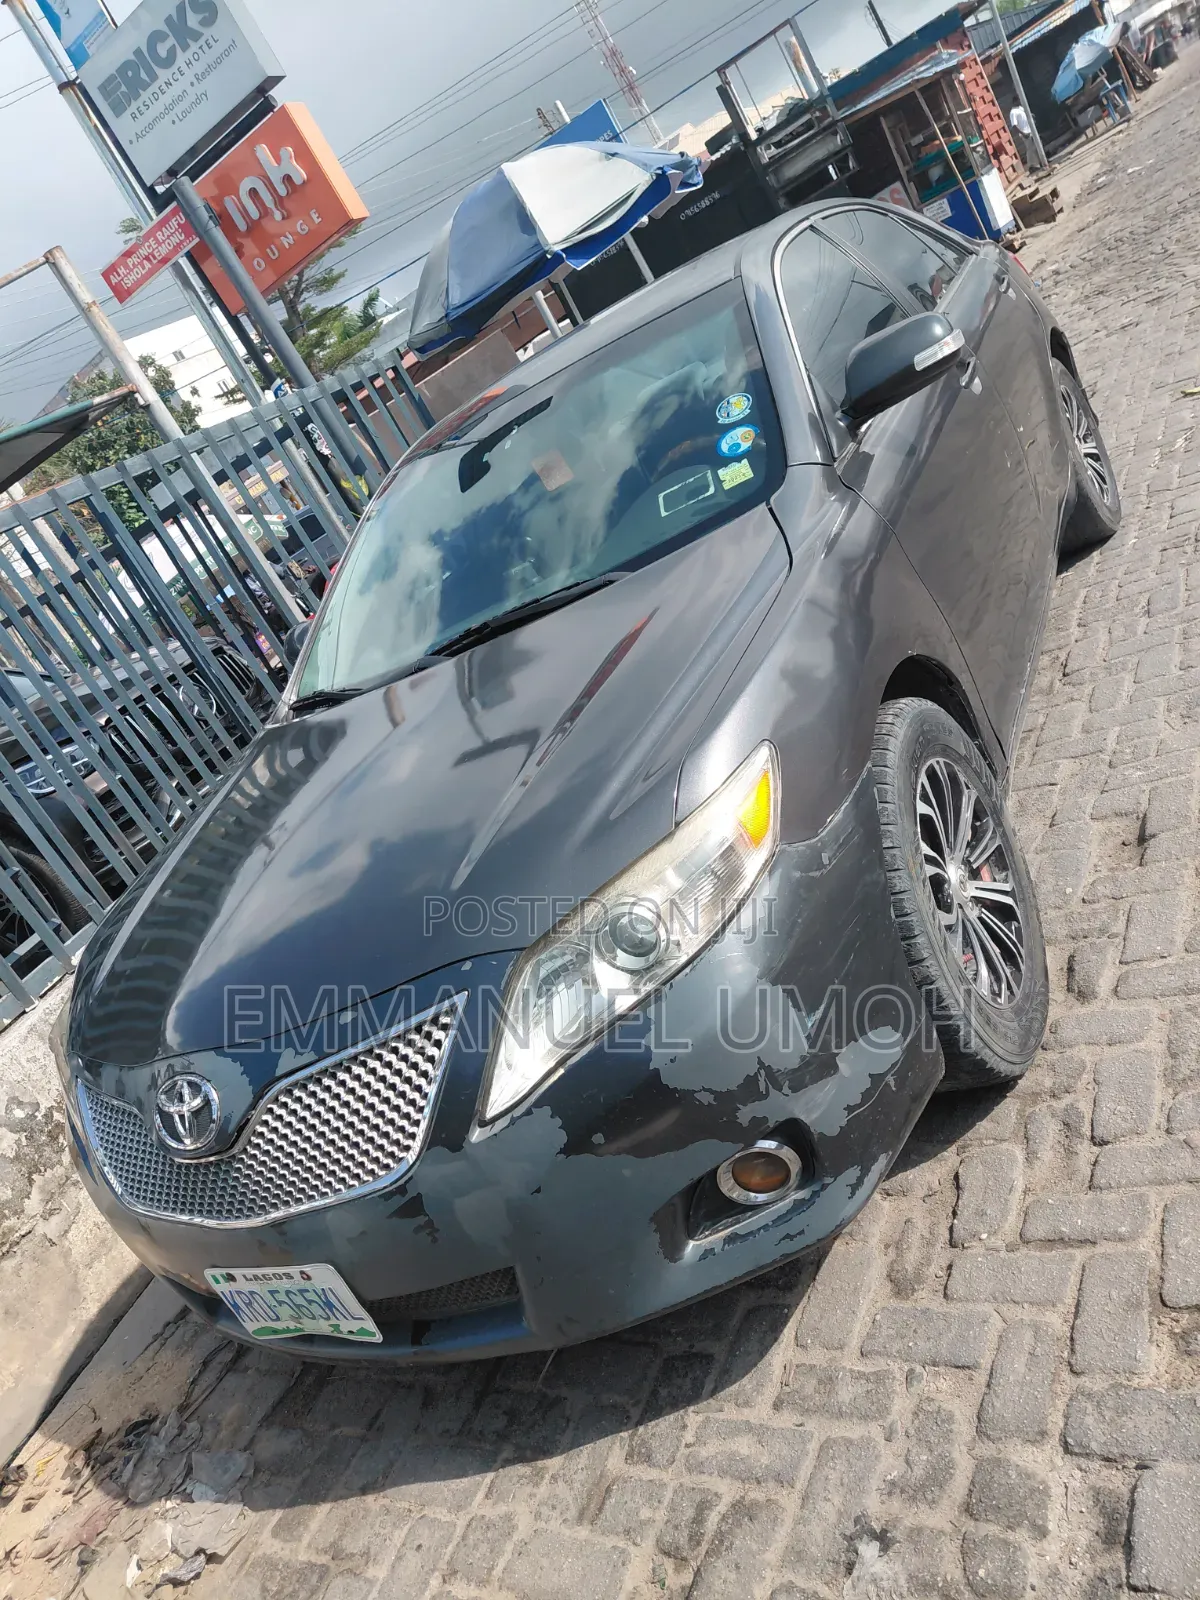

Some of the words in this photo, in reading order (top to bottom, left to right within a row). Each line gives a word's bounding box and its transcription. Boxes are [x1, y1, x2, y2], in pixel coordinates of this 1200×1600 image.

[97, 0, 218, 118] ERICKS
[130, 66, 186, 122] RESIDENCE
[185, 34, 220, 70] HOTEL
[134, 88, 189, 143] Accomodation
[177, 89, 210, 122] Laundry
[109, 264, 130, 286] ALH.
[126, 237, 159, 269] PRINCE
[155, 212, 186, 243] RAUFU
[120, 260, 152, 290] ISHOLA
[149, 228, 186, 264] LEMONU
[249, 208, 322, 279] OUNGE
[241, 1271, 295, 1283] LAGOS
